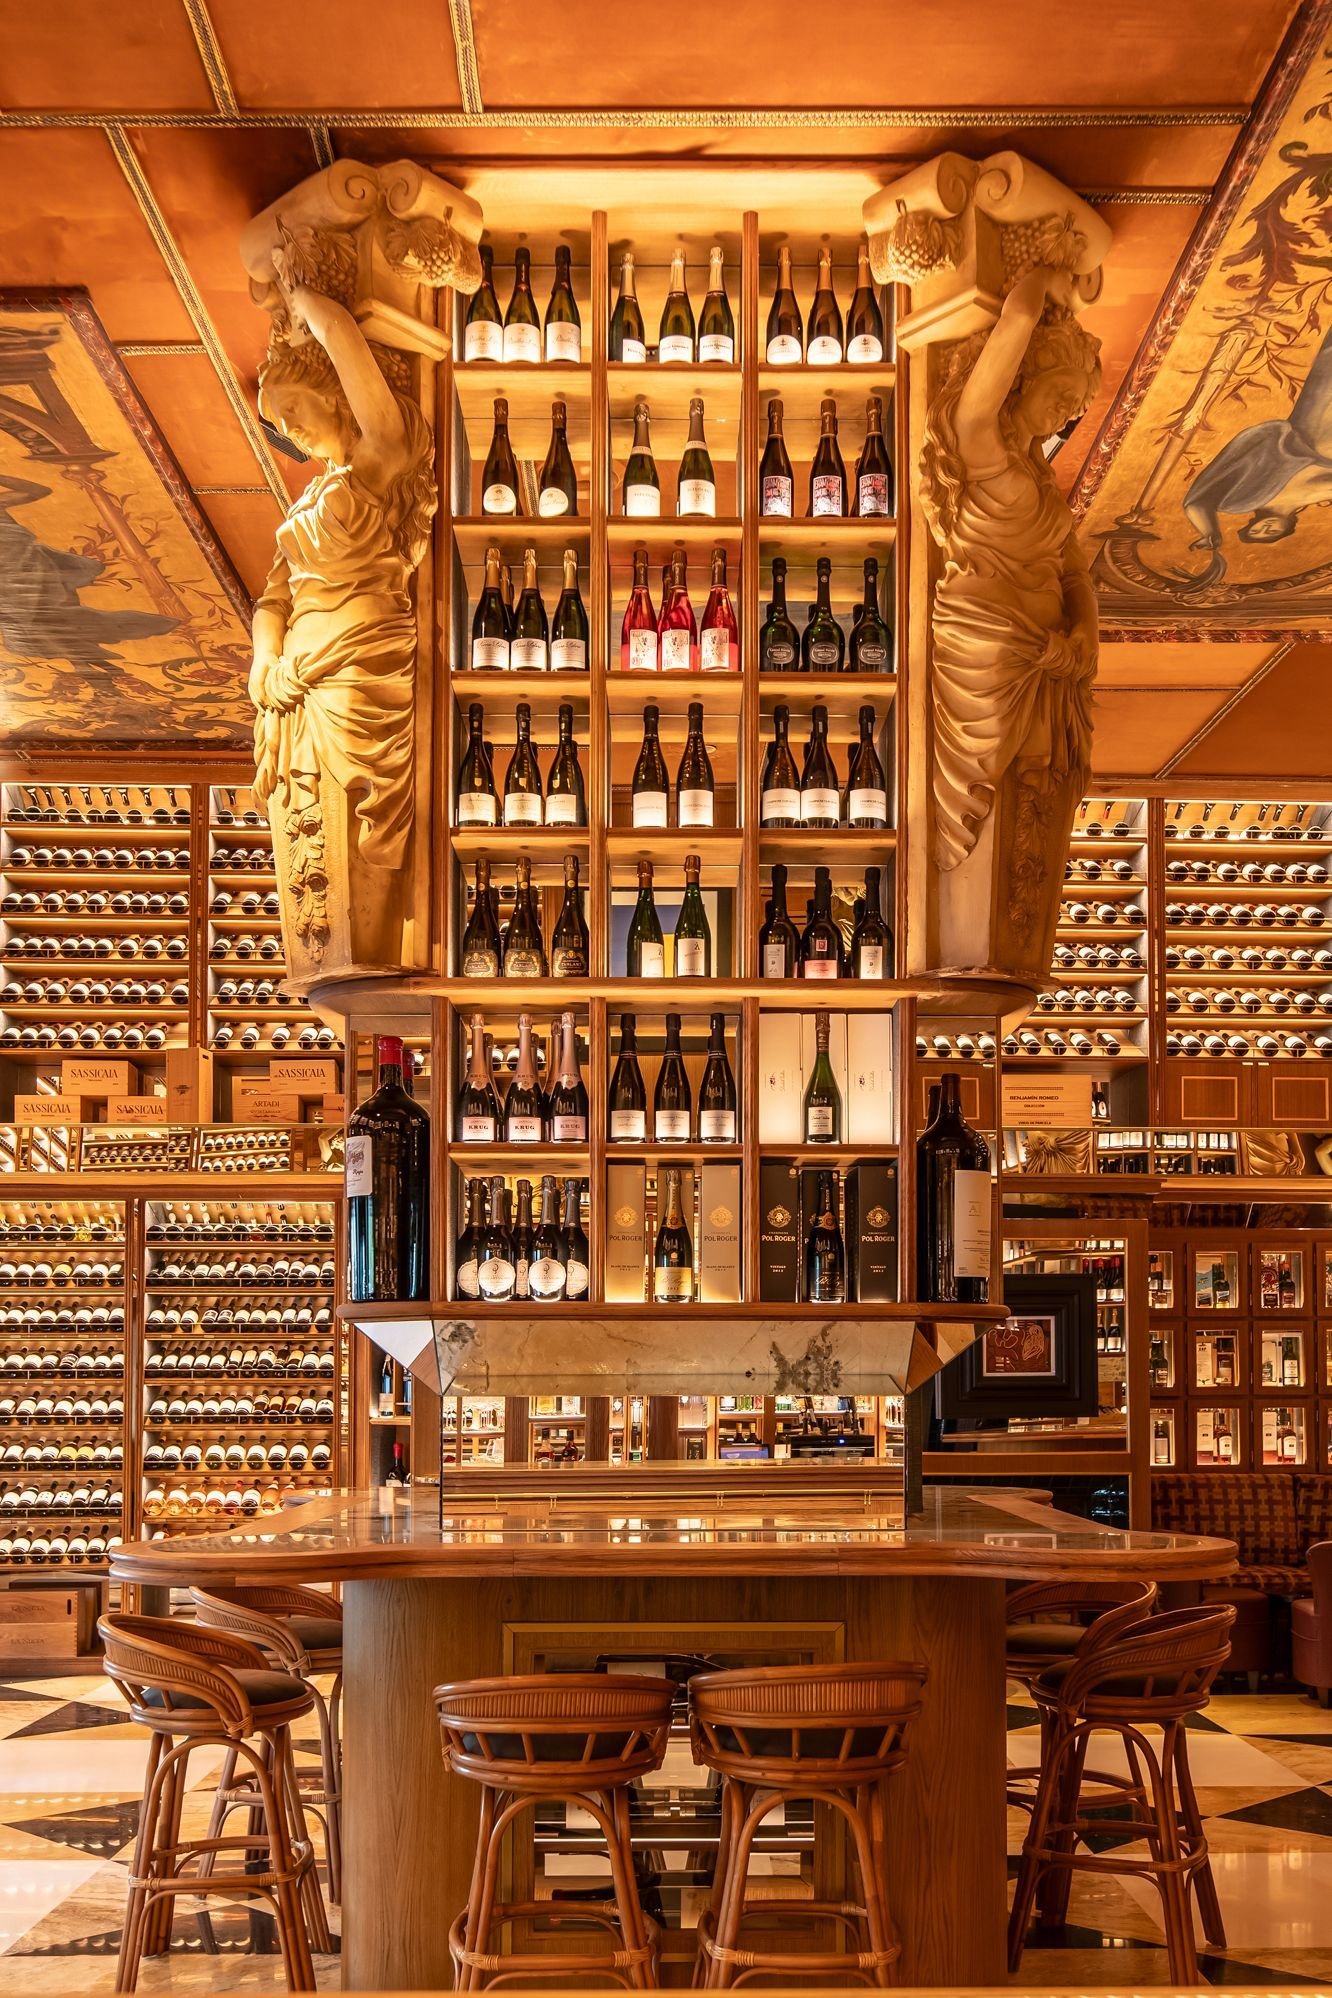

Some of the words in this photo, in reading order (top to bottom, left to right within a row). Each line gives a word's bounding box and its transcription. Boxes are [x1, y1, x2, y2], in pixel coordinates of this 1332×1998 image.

[70, 1068, 118, 1079] SASSICAIA
[278, 1068, 326, 1078] SASSICAIA
[23, 1103, 71, 1114] SASSICAIA
[252, 1100, 280, 1108] ARTADI
[116, 1104, 164, 1115] SASSICAIA
[621, 1234, 643, 1242] ROGER
[761, 1234, 774, 1242] POL
[774, 1234, 796, 1242] ROGER
